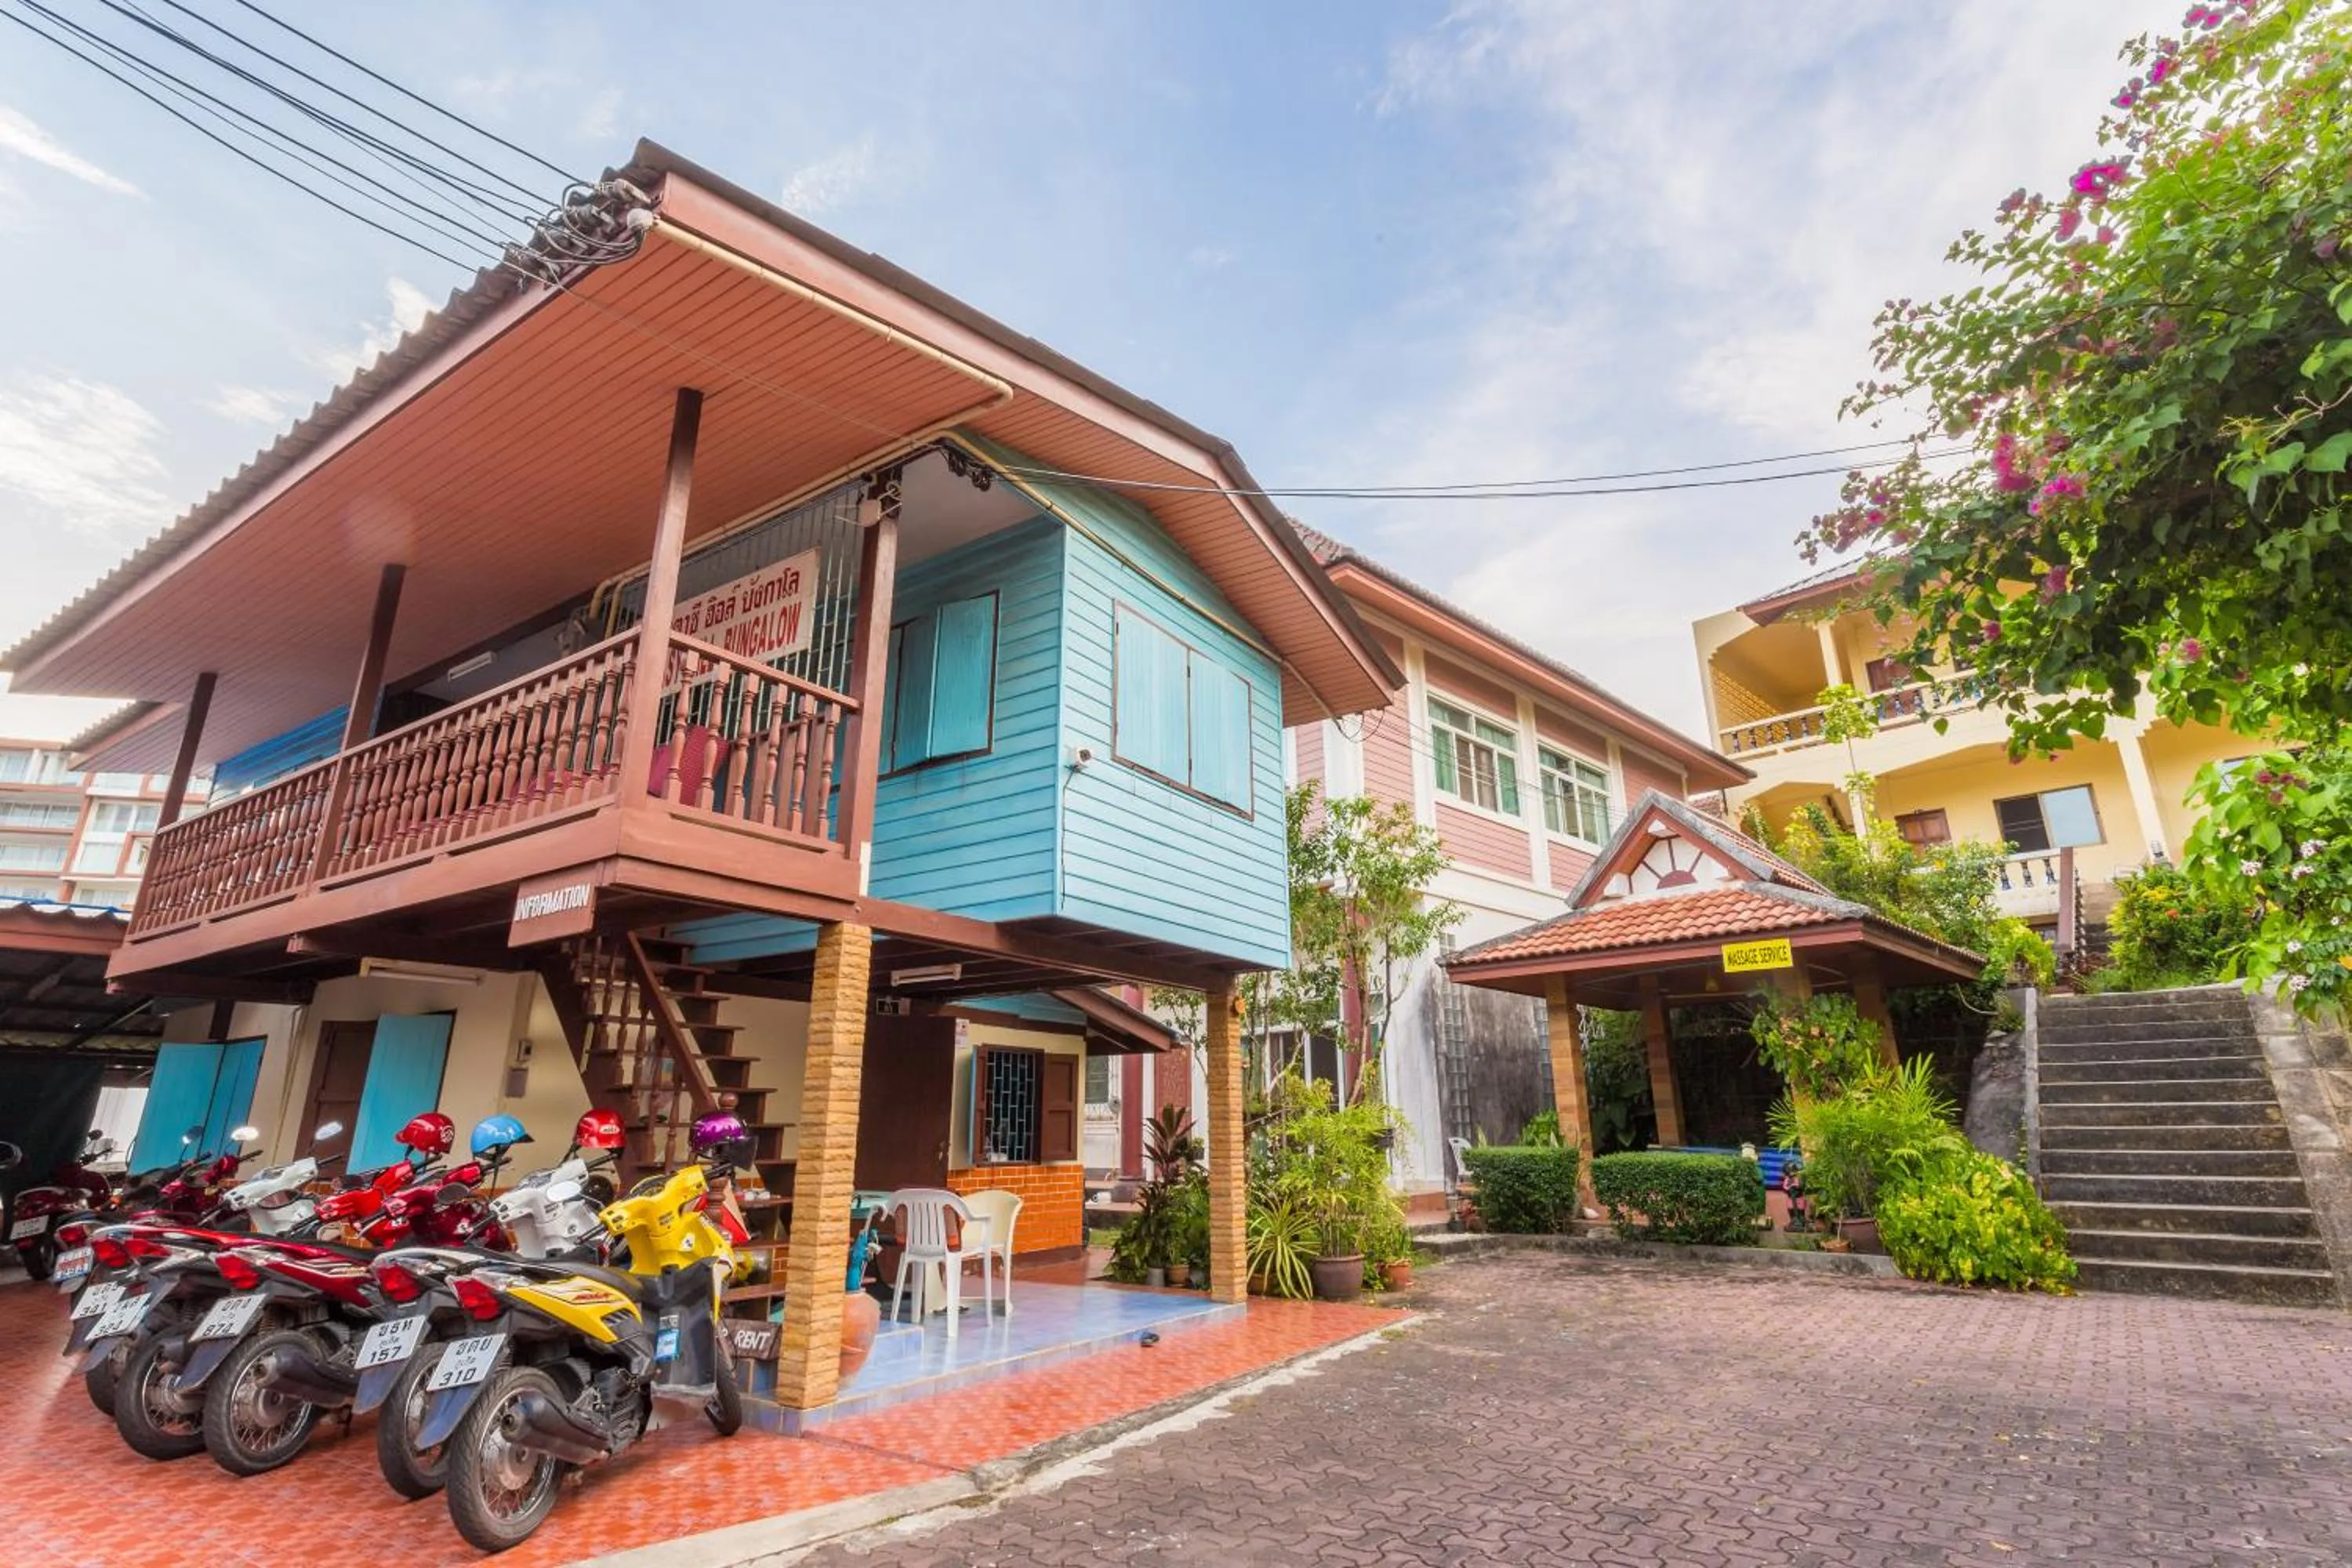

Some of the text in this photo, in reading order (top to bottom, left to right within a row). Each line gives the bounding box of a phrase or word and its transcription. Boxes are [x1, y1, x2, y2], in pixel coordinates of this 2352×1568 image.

[724, 601, 801, 658] BUNGALOW
[514, 883, 590, 922] INFORMATION
[1727, 946, 1788, 967] MASSAGE SERVICE
[734, 1330, 771, 1350] RENT
[370, 1345, 402, 1363] 157
[439, 1367, 477, 1386] 310
